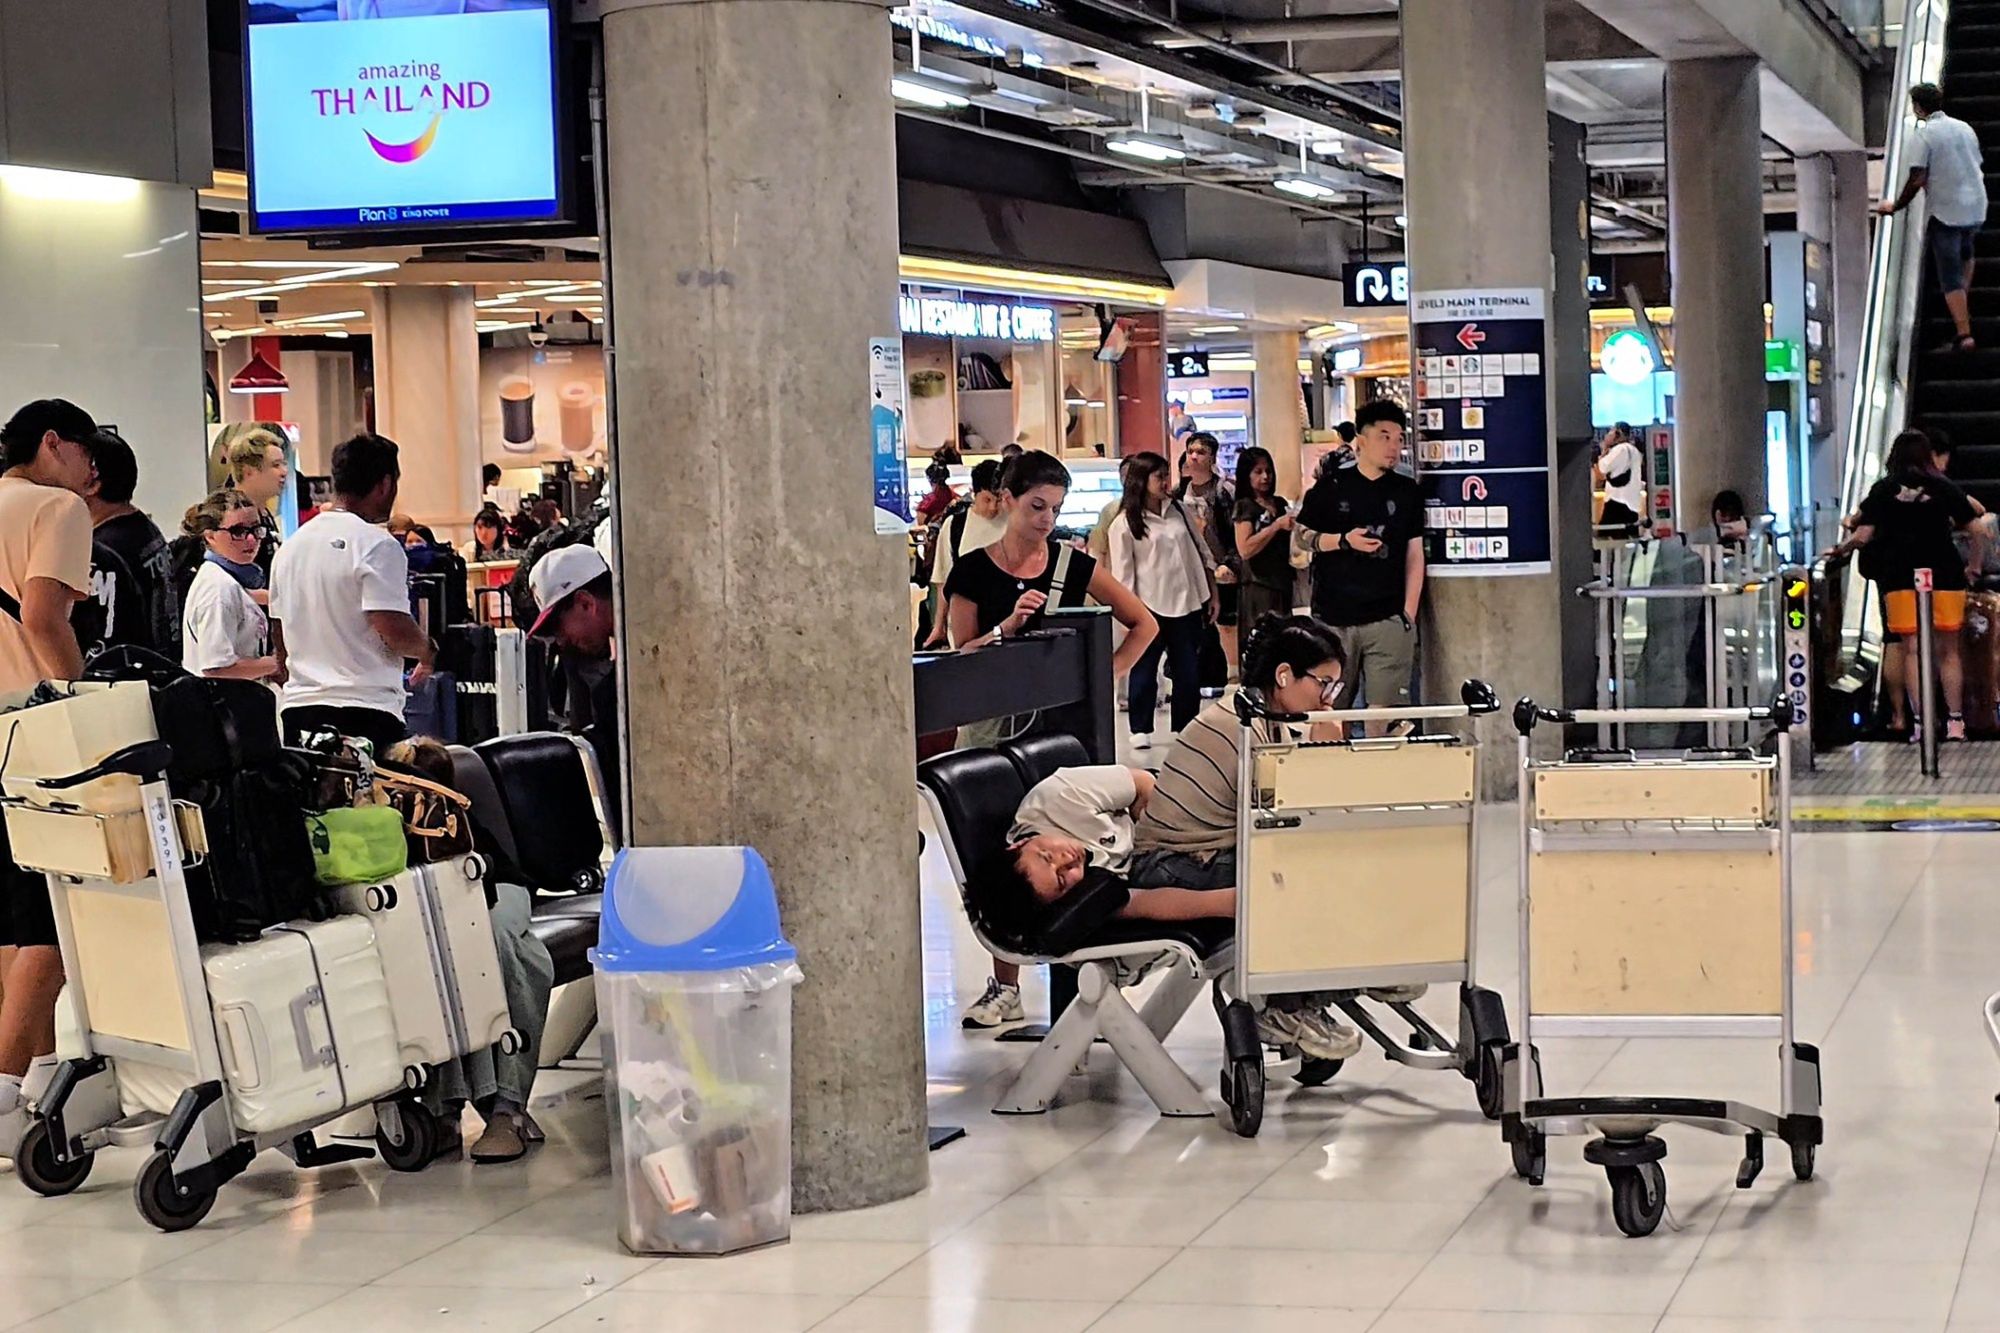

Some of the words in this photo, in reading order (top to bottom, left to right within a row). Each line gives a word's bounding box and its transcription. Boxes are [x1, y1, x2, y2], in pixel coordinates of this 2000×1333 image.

[358, 60, 441, 81] amazing
[311, 81, 490, 116] THAILAND
[1447, 297, 1475, 307] MAIN
[1478, 296, 1530, 306] TERMINAL
[1468, 444, 1479, 456] P
[1493, 540, 1503, 553] P
